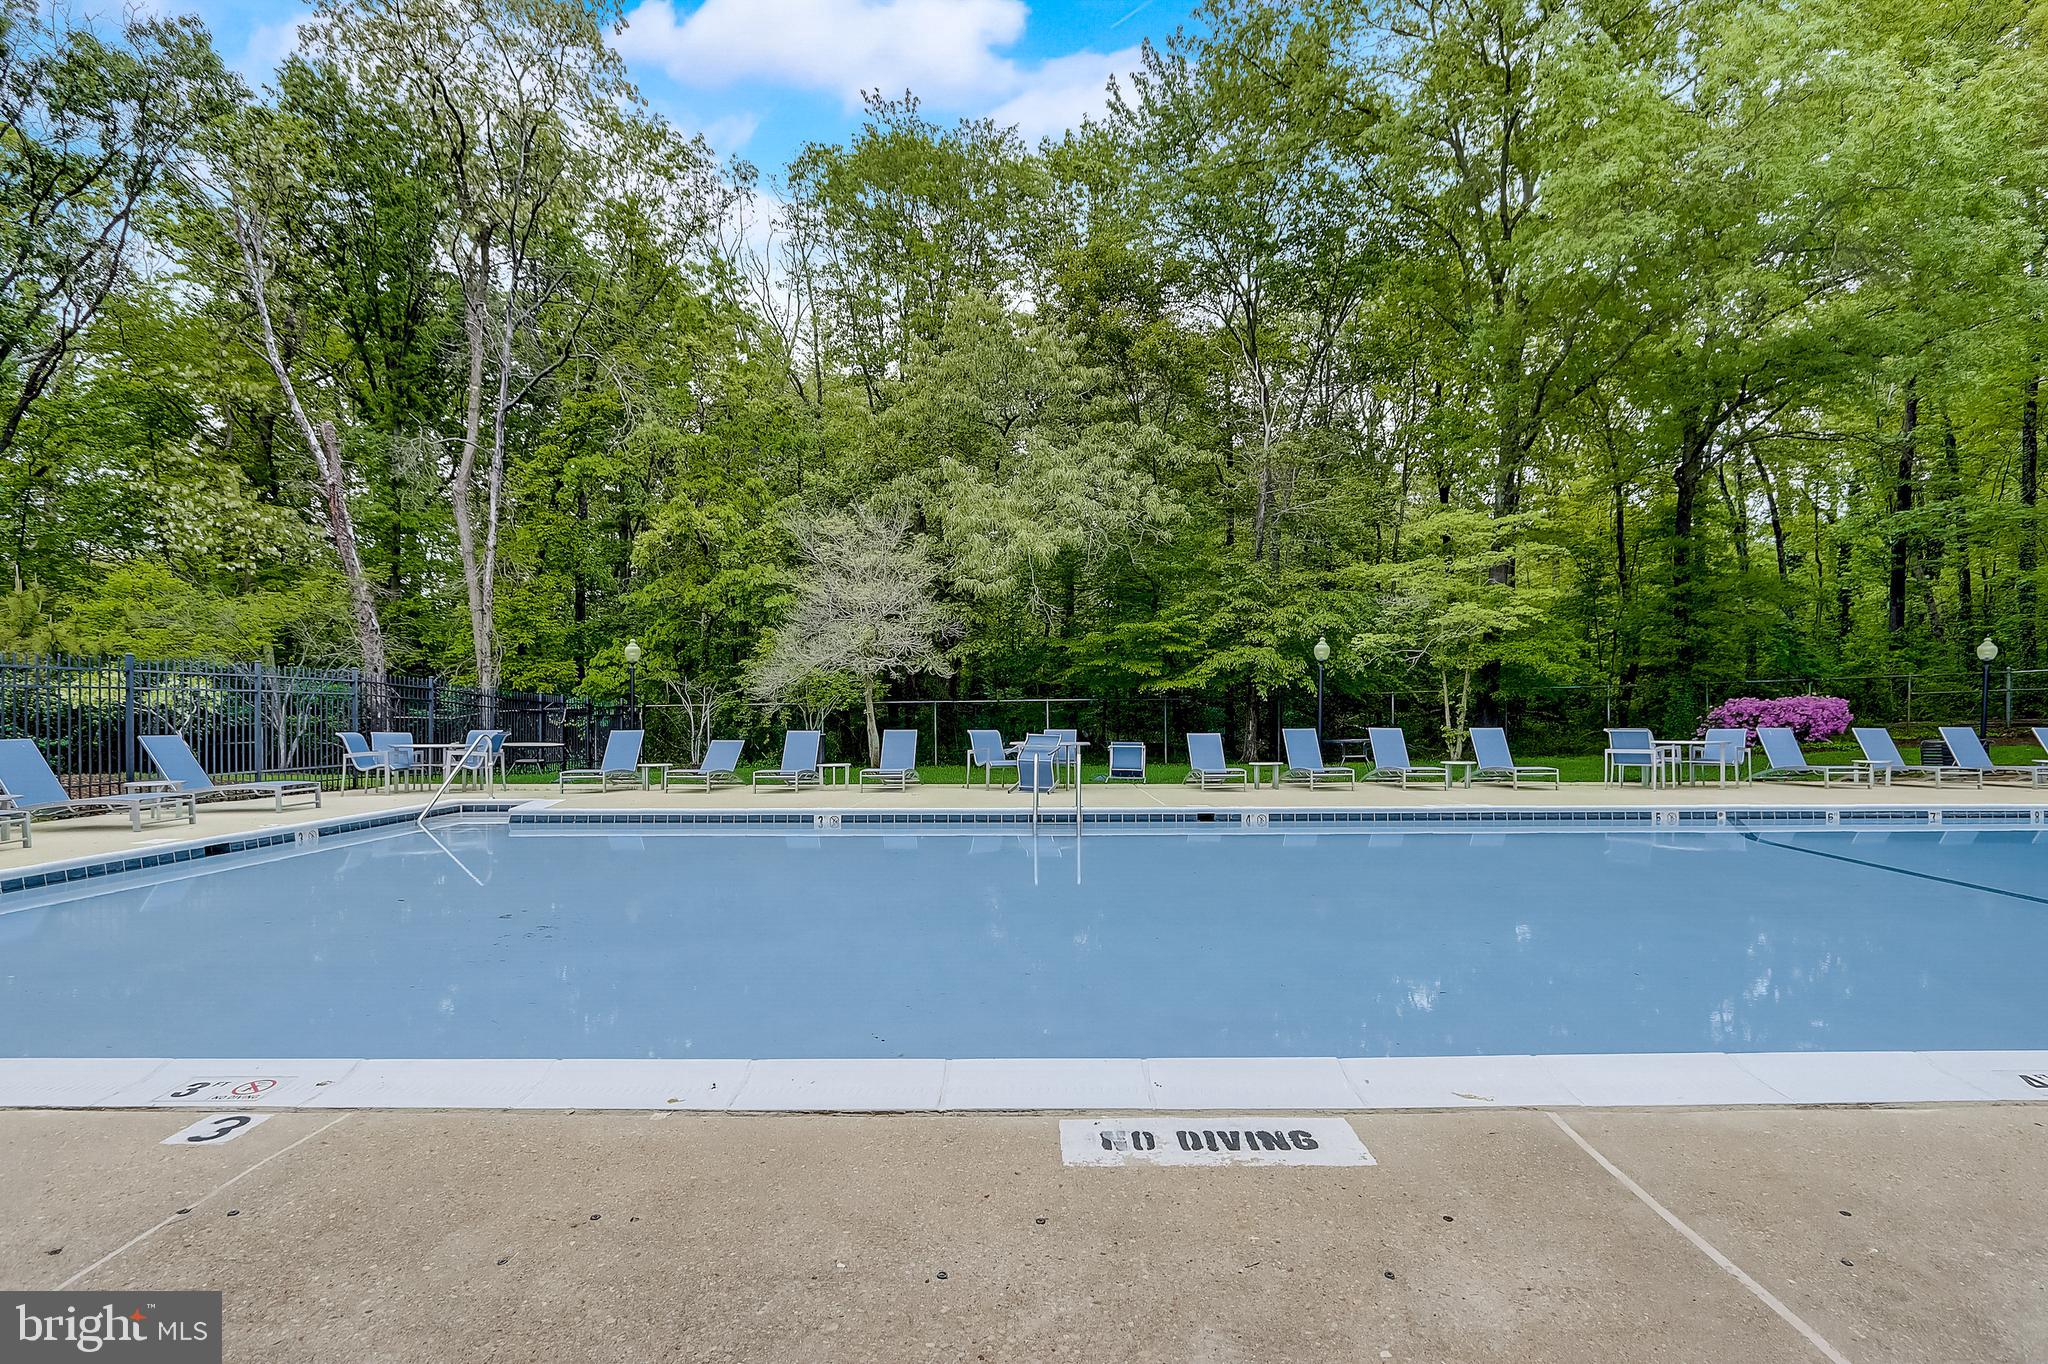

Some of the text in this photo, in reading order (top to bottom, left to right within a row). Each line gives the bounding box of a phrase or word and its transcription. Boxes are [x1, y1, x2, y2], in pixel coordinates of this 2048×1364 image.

[170, 1082, 211, 1097] 3
[187, 1116, 251, 1142] 3
[1099, 1130, 1319, 1152] NO DIVING
